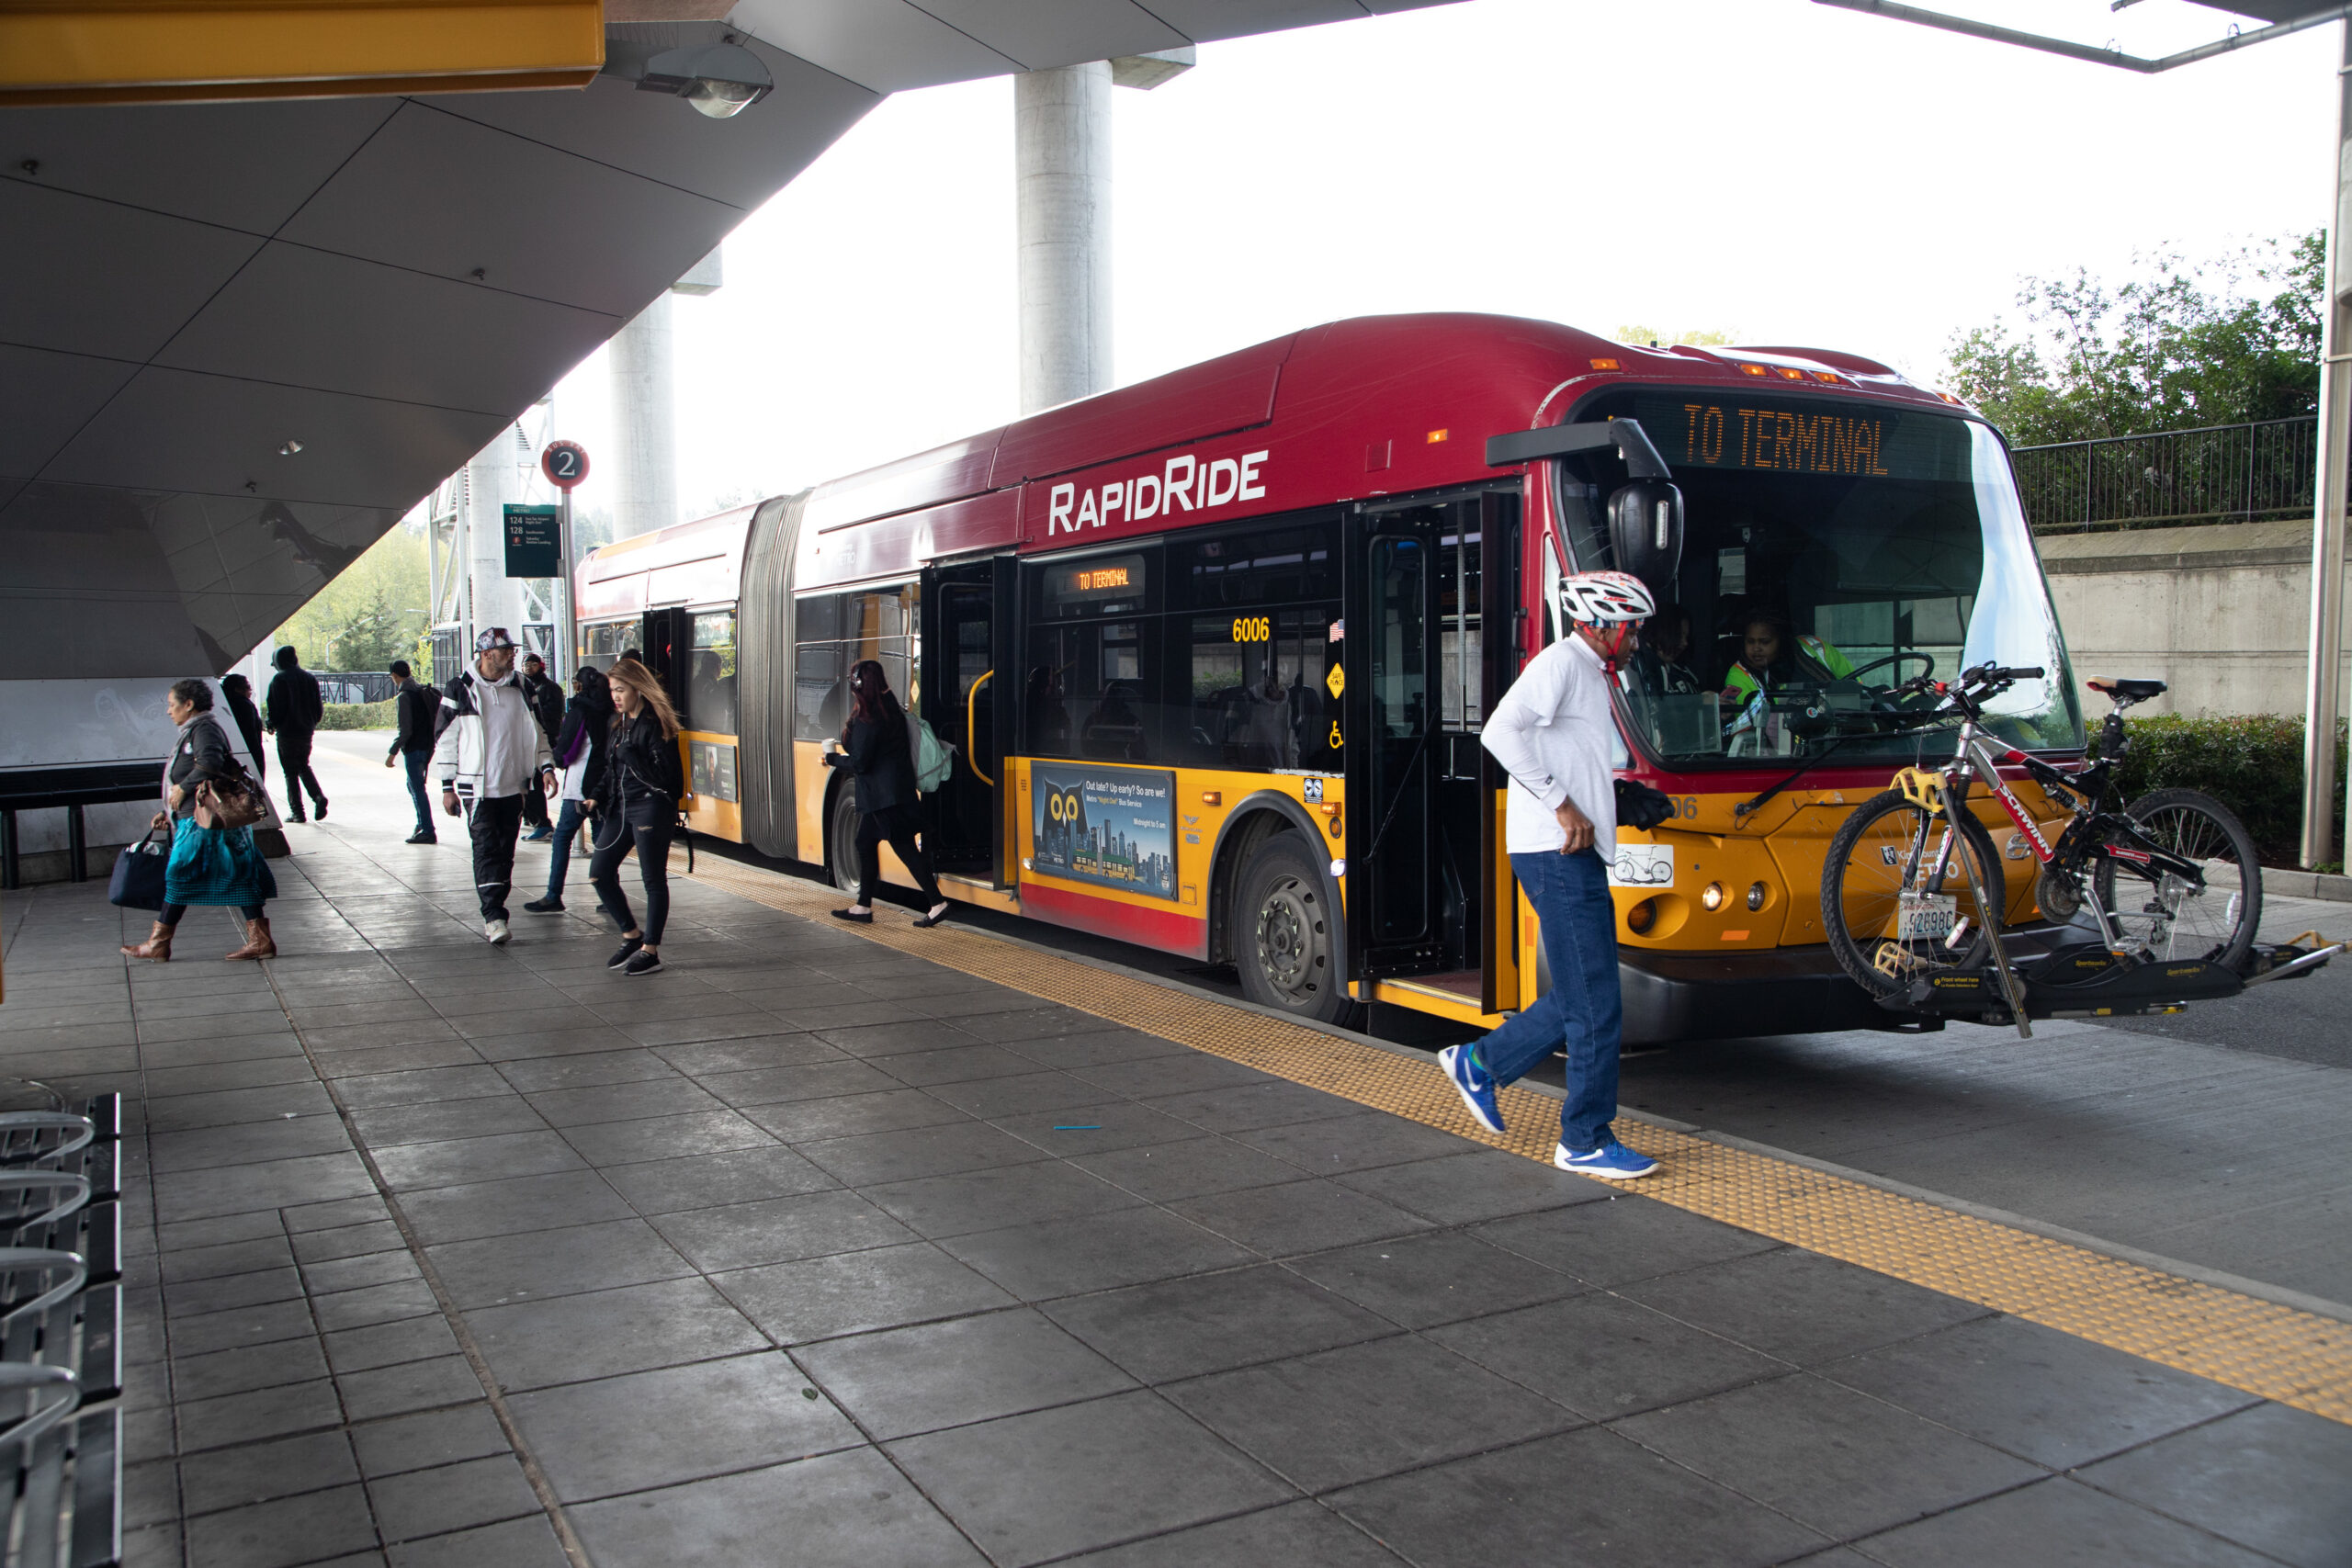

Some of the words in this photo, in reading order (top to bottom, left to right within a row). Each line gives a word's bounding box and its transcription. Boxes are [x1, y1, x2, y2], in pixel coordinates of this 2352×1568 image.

[1684, 404, 1723, 464] TO
[1738, 409, 1888, 476] TERMINAL
[558, 451, 575, 476] 2
[509, 516, 523, 525] 124
[510, 526, 524, 535] 128
[1080, 572, 1090, 591] TO
[1092, 567, 1129, 589] TERMINAL
[1232, 616, 1271, 642] 6006
[1086, 780, 1095, 791] Out
[1096, 782, 1109, 793] late?
[1109, 783, 1118, 795] Up
[1118, 784, 1136, 796] early?
[1136, 784, 1144, 795] So
[1144, 788, 1155, 796] are
[1155, 787, 1166, 798] we!
[1118, 797, 1126, 807] Bus
[1126, 798, 1142, 808] Service
[1998, 783, 2053, 856] SCHWINN
